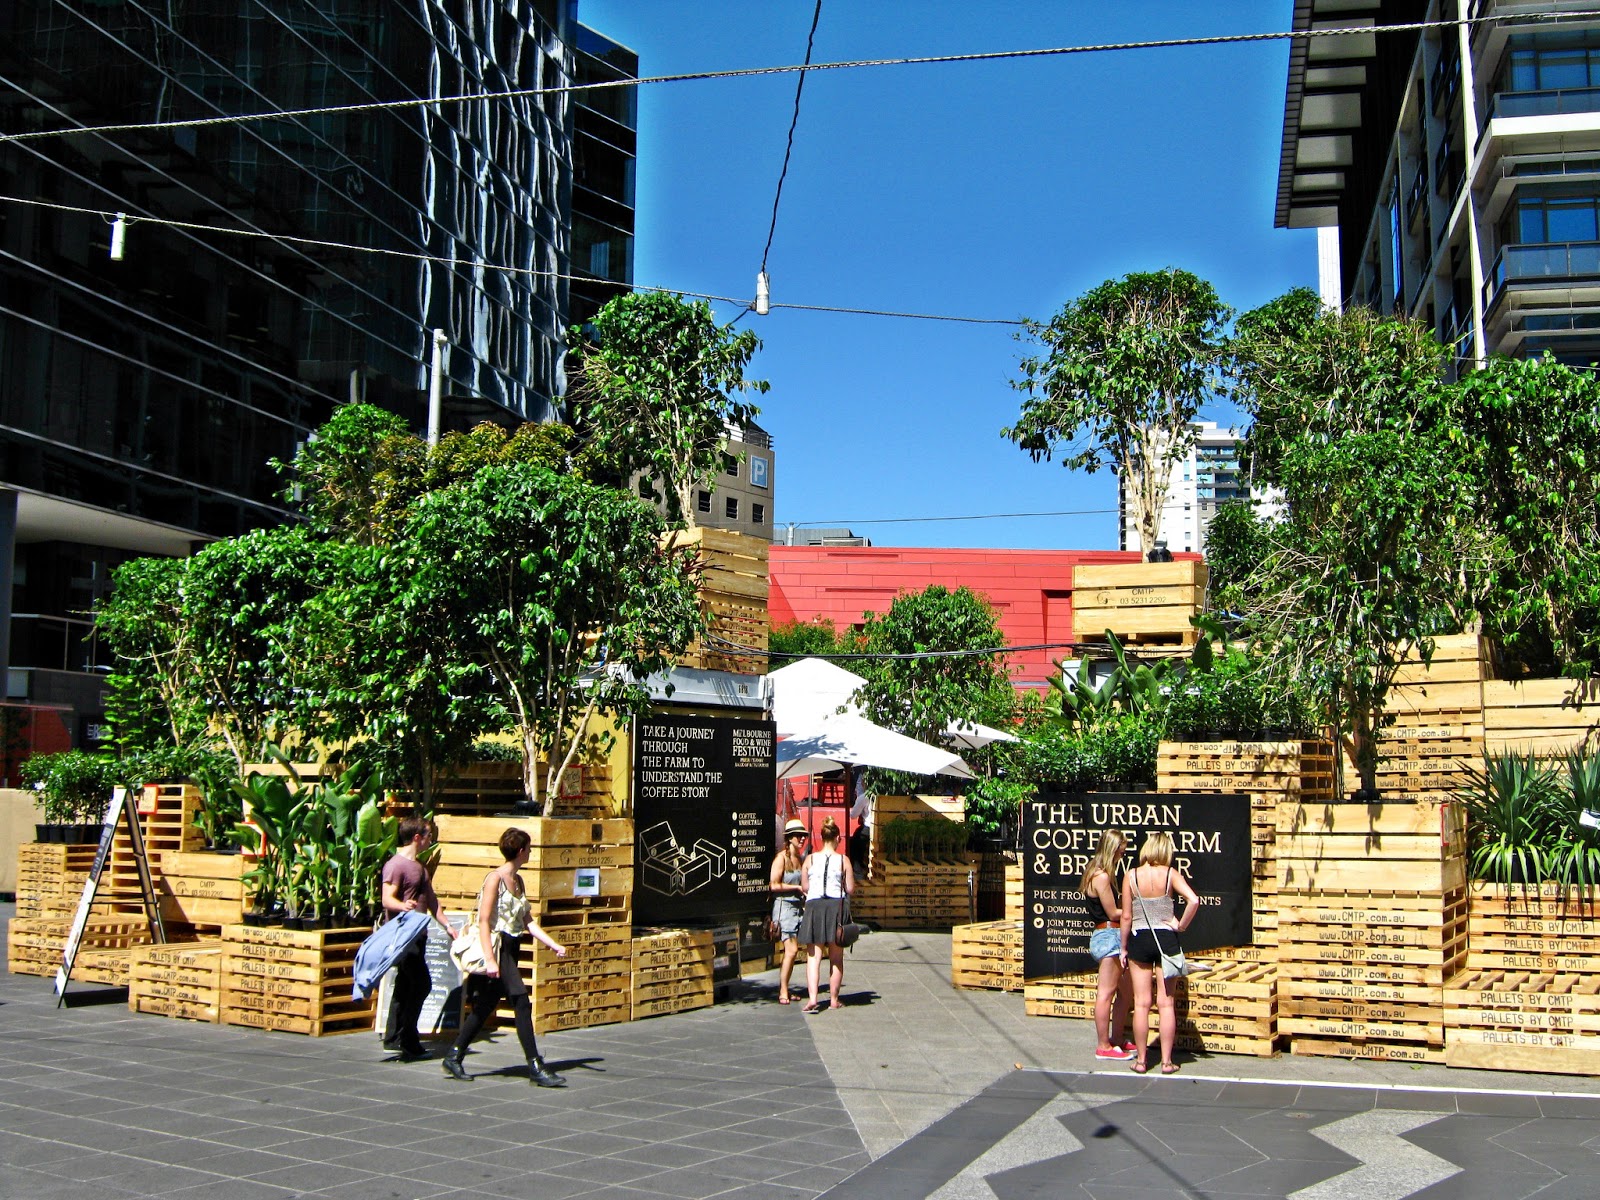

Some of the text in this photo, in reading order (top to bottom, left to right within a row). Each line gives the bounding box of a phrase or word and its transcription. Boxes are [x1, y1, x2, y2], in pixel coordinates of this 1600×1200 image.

[755, 461, 764, 482] P
[643, 726, 714, 740] TAKE A JOURNEY
[732, 729, 772, 738] MELBOURNE
[642, 740, 688, 753] THROUGH
[732, 738, 772, 746] FOOD & WINE
[732, 746, 772, 757] FESTIVAL
[642, 756, 704, 768] THE FARM TO
[1186, 761, 1220, 770] PALLETS
[1226, 761, 1236, 770] BY
[642, 771, 722, 783] UNDERSTAND THE
[1194, 778, 1268, 788] www.CMTP.com.au
[642, 786, 710, 798] COFFEE STORY
[1032, 803, 1182, 826] THE URBAN
[1033, 828, 1138, 850] COFFE
[1034, 853, 1134, 876] & BRW
[1033, 890, 1058, 900] PICK
[1178, 896, 1222, 905] ENTS
[1047, 906, 1090, 914] DOWNLOA
[1320, 912, 1405, 922] www.CMTP.com.au
[1046, 920, 1064, 928] JOIN
[1066, 920, 1082, 928] THE
[1504, 921, 1588, 932] PALLETS BY CMTP
[558, 929, 607, 941] PALLETS BY CMTP
[1046, 928, 1092, 936] @melbfoodan
[1319, 930, 1405, 942] www.CMTP.com.au
[1504, 940, 1589, 950] PALLETS BY CMTP
[242, 945, 294, 959] PALLETS BY CMTP
[1241, 950, 1261, 959] CMTP
[1320, 950, 1406, 961] www.CMTP.com.au
[149, 952, 196, 965] PALLETS BY CMTP
[651, 955, 671, 964] PALLETS
[673, 954, 679, 963] BY
[1503, 957, 1588, 968] PALLETS BY CMTP
[242, 962, 292, 976] PALLETS BY CMTP
[558, 964, 606, 976] PALLETS BY CMTP
[1319, 968, 1404, 980] www.CMTP.com.au
[1052, 989, 1085, 999] PALLETS
[1189, 983, 1200, 991] BY
[1205, 983, 1227, 993] CMTP
[1319, 987, 1405, 999] www.CMTP.com.au
[240, 996, 292, 1011] PALLETS BY CMTP
[1480, 993, 1572, 1006] PALLETS BY CMTP
[651, 1003, 671, 1012] PALLETS
[673, 1002, 680, 1010] BY
[1054, 1005, 1086, 1015] PALLETS
[1320, 1006, 1406, 1018] www.CMTP.com.au
[1481, 1012, 1573, 1027] PALLETS BY CMTP
[1319, 1024, 1405, 1037] www.CMTP.com.au
[1483, 1032, 1575, 1047] PALLETS BY CMTP
[1339, 1047, 1425, 1059] www.CMTP.com.au
